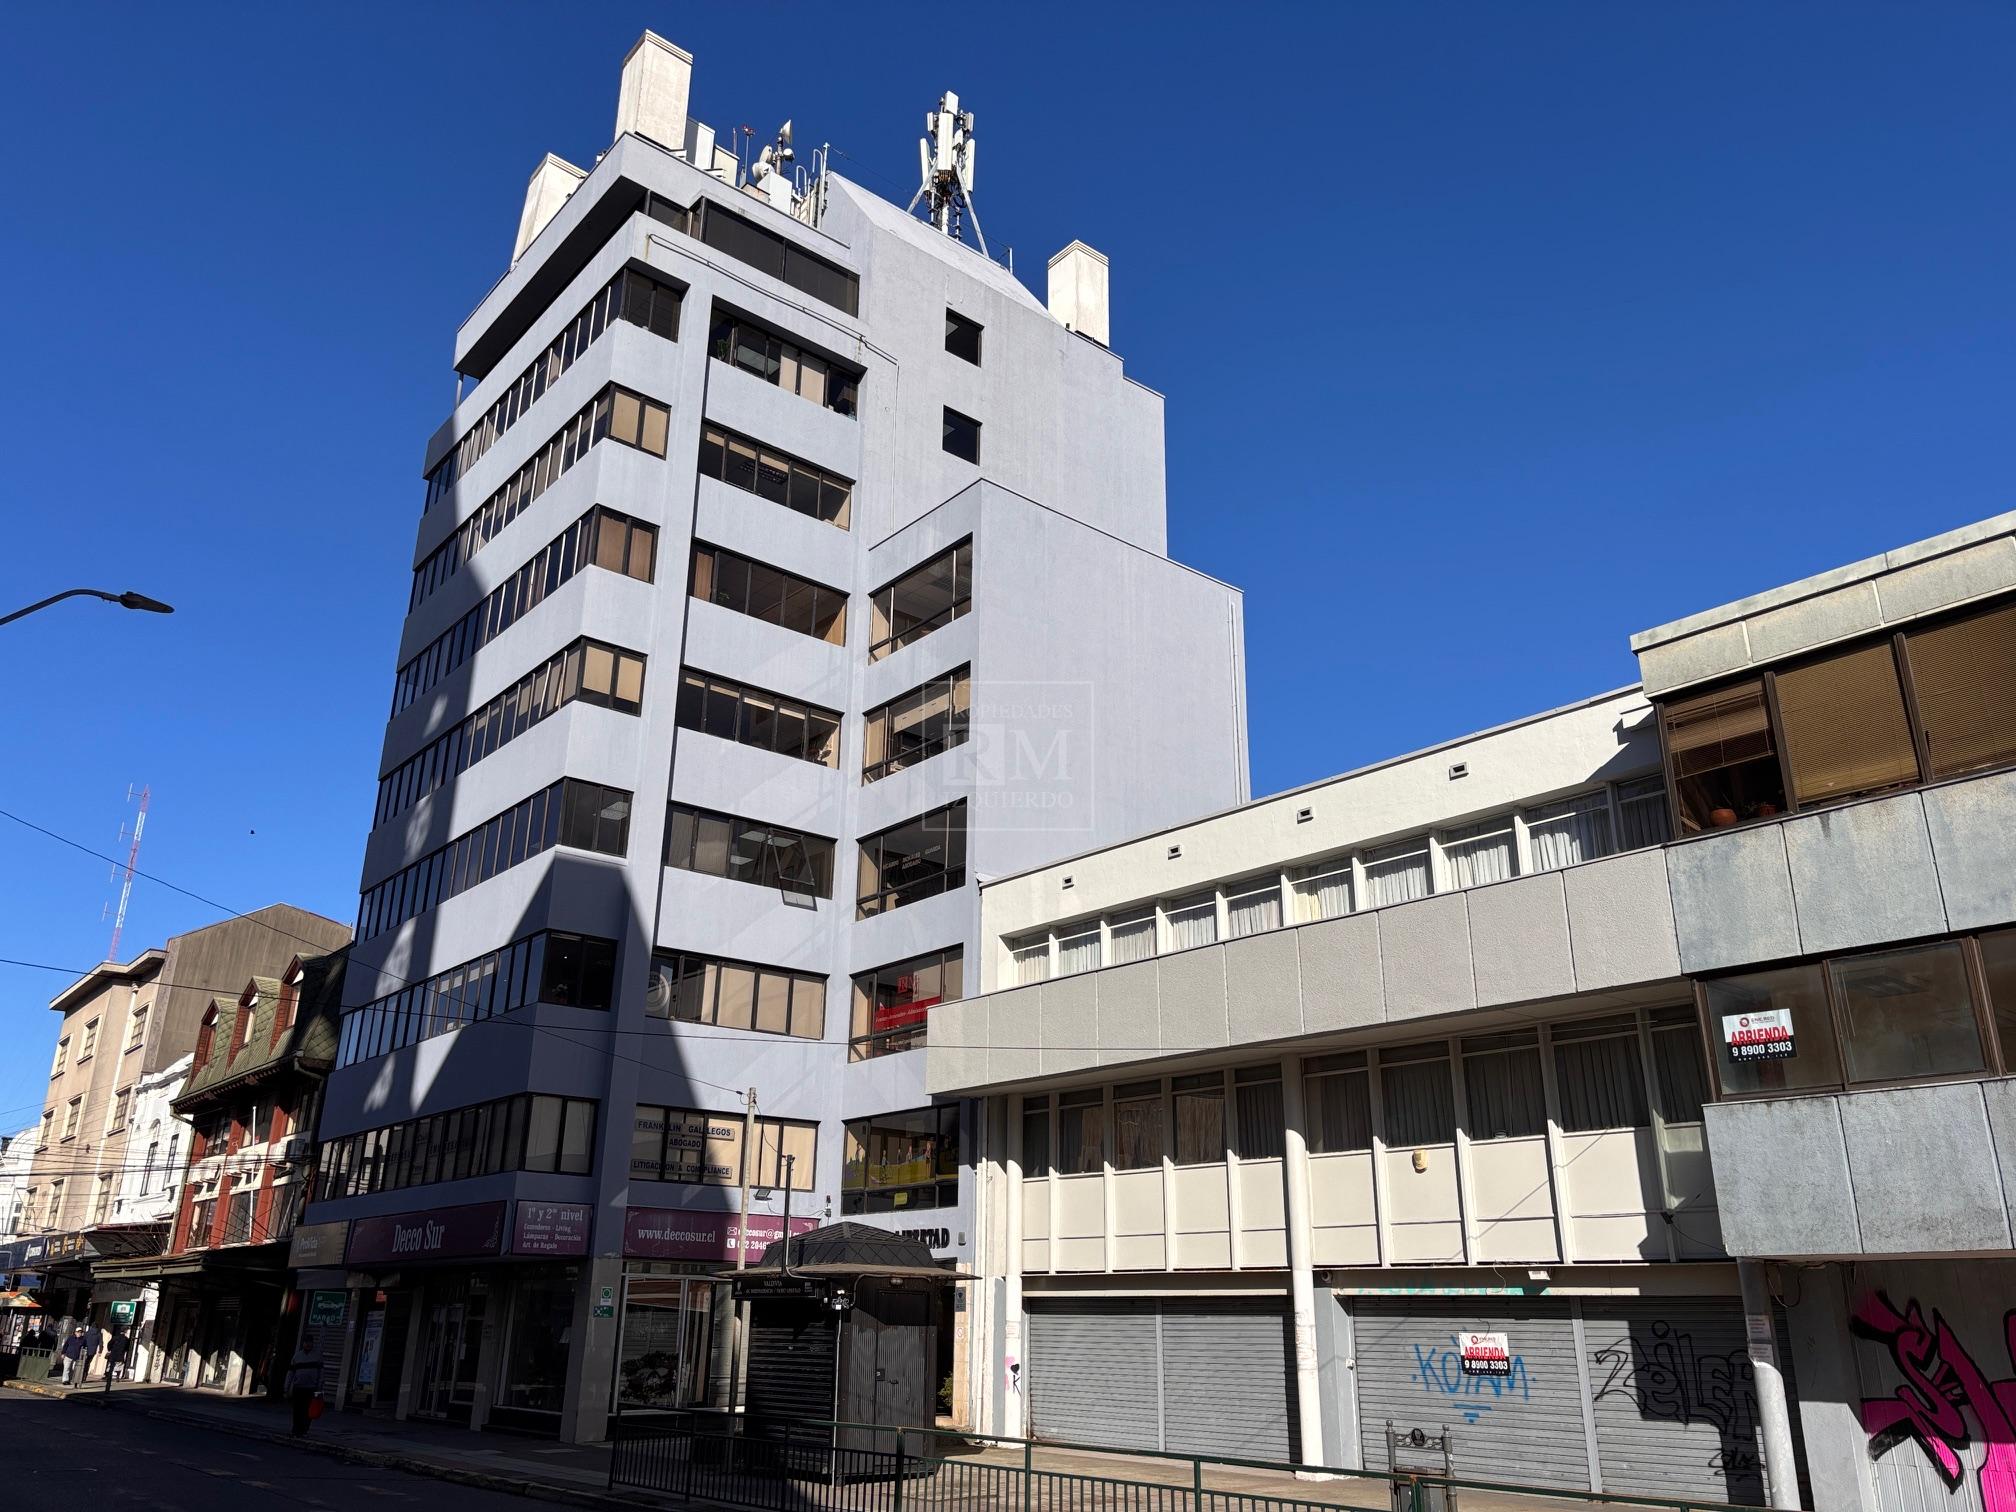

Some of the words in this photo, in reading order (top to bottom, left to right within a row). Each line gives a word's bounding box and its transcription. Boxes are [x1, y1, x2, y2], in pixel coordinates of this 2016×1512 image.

[1730, 1026, 1790, 1045] ARRIENDA
[1732, 1047, 1739, 1057] 9
[1741, 1044, 1765, 1056] 8900
[1767, 1041, 1792, 1053] 3303
[638, 1121, 682, 1134] FRANKLIN
[688, 1126, 731, 1138] GALLEGOS
[669, 1138, 702, 1149] ABOGADO
[686, 1165, 730, 1176] COMPLIANCE
[561, 1209, 583, 1222] nivel
[392, 1225, 423, 1253] Decco
[424, 1219, 446, 1251] Sur
[638, 1228, 716, 1243] www.deccosur.cl
[1464, 1346, 1507, 1360] ARRIENDA
[1464, 1360, 1470, 1369] 9
[1471, 1360, 1489, 1369] 8900
[1490, 1361, 1508, 1370] 3303
